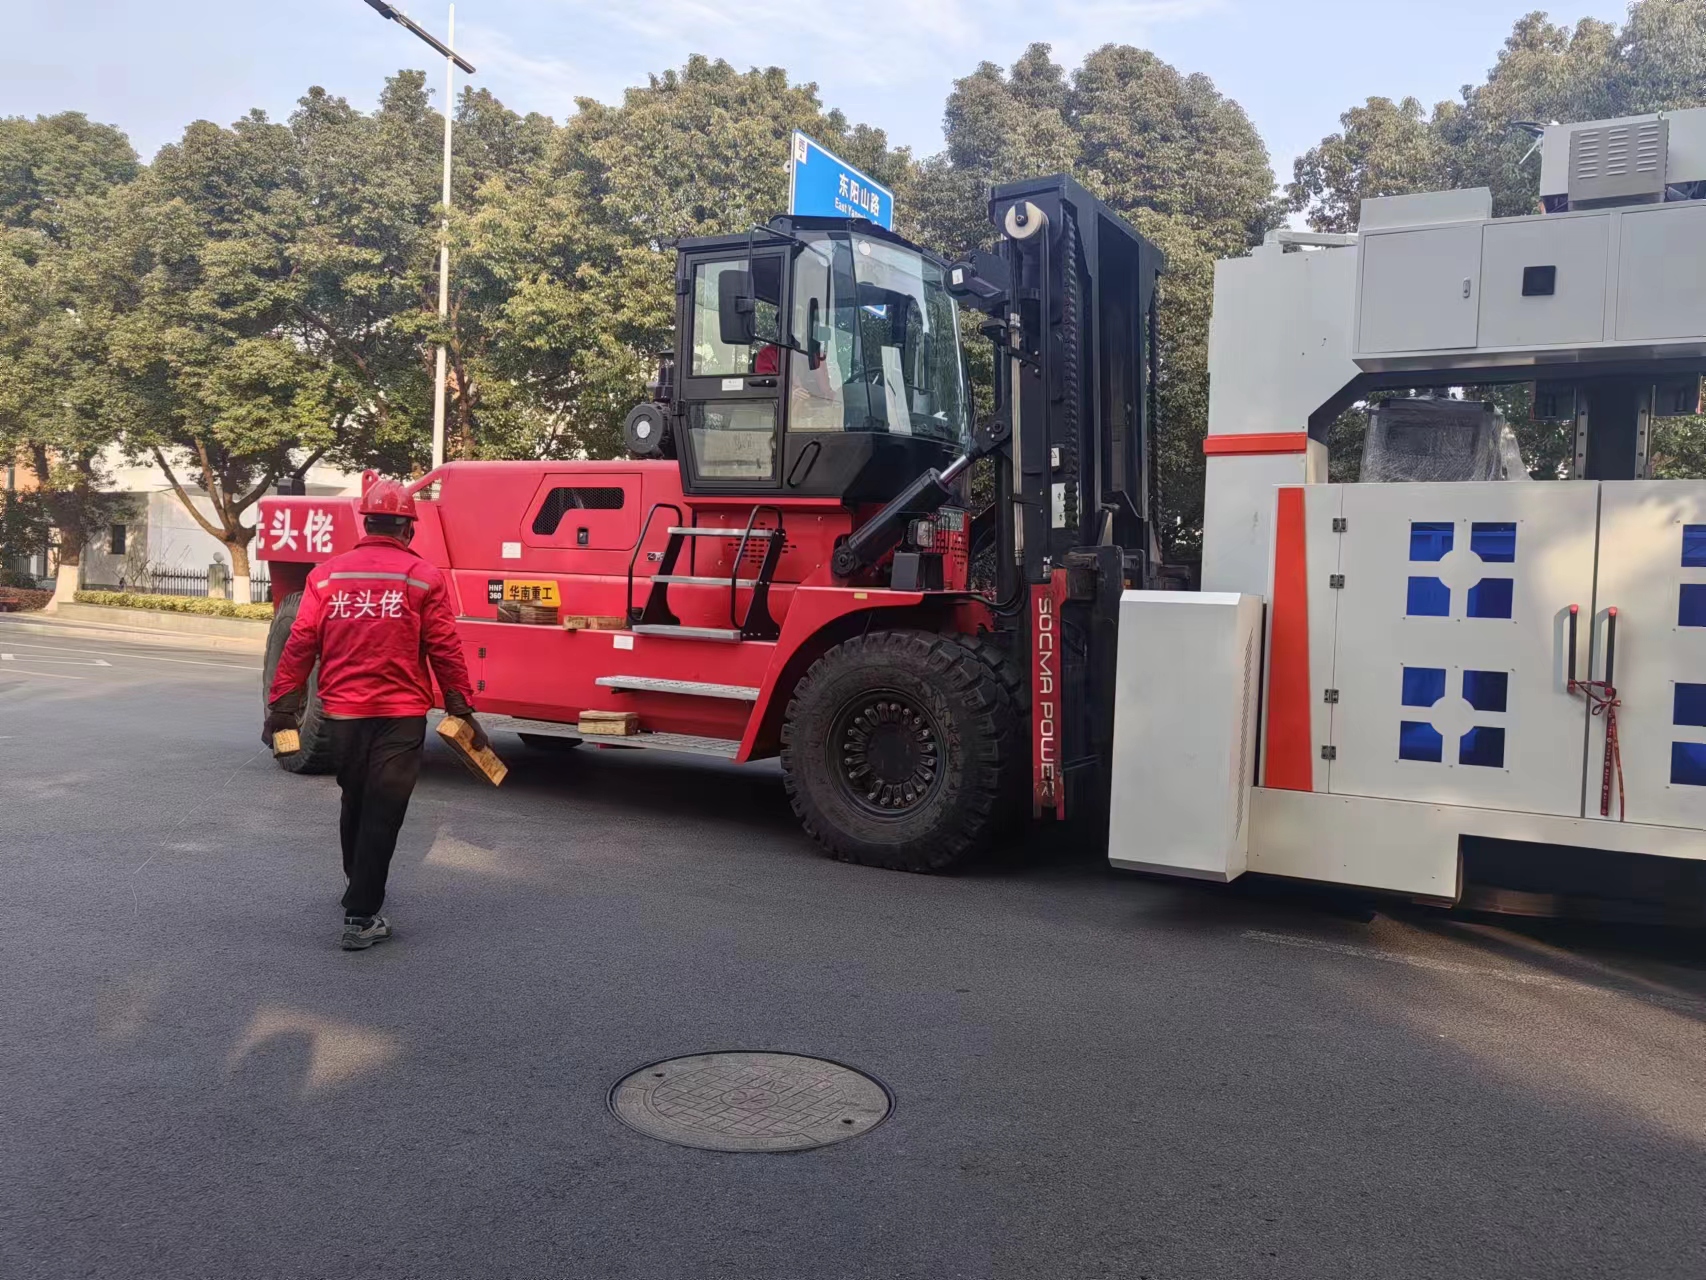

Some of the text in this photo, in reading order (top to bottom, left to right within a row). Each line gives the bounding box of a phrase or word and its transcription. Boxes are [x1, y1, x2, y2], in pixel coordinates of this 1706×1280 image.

[838, 172, 879, 217] 东阳山路
[488, 584, 503, 592] HNF
[509, 585, 553, 600] 华南重工
[328, 589, 404, 619] 光头佬
[1038, 597, 1053, 694] SOCMA
